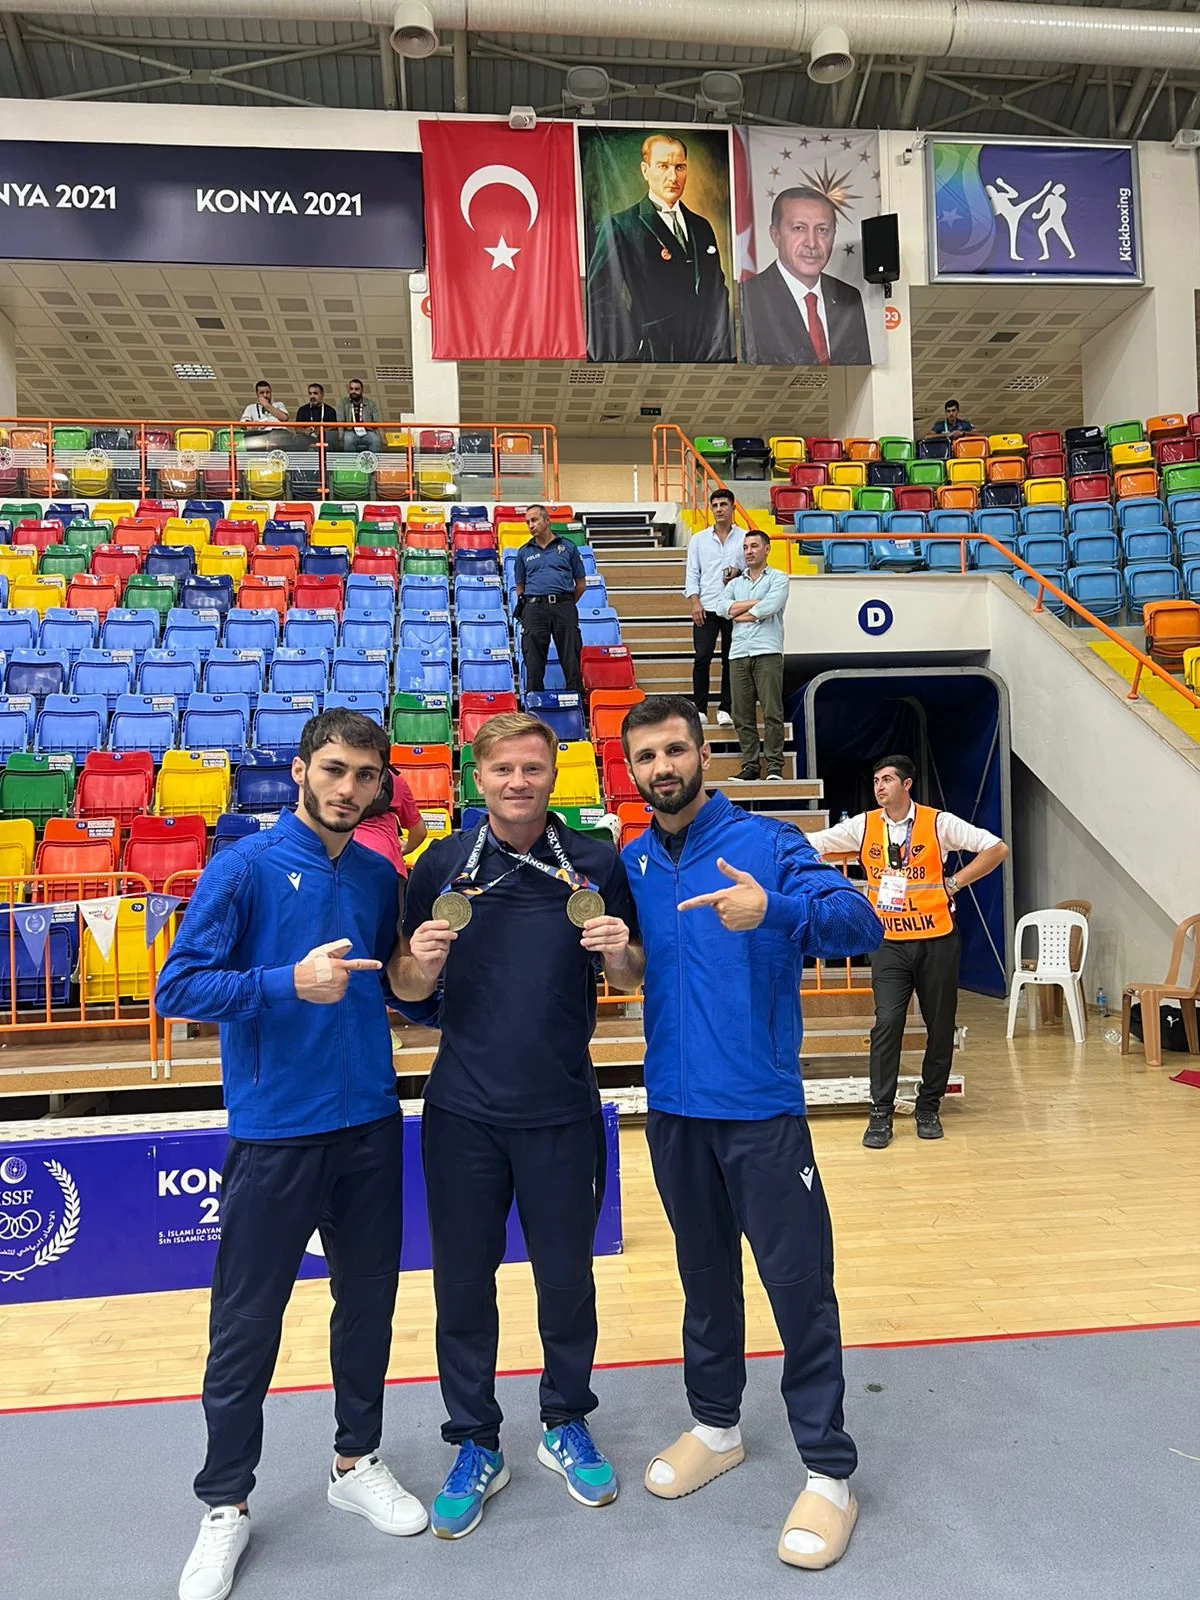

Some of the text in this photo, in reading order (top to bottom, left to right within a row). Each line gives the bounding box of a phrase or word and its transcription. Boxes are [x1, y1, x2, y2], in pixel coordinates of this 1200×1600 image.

[0, 183, 117, 210] NYA 2021
[196, 188, 362, 217] KONYA 2021
[1118, 187, 1132, 262] Kickboxing
[866, 607, 886, 628] D
[158, 1167, 223, 1197] KON
[173, 1234, 206, 1244] ISLAMIC
[195, 1227, 222, 1235] DAYAN
